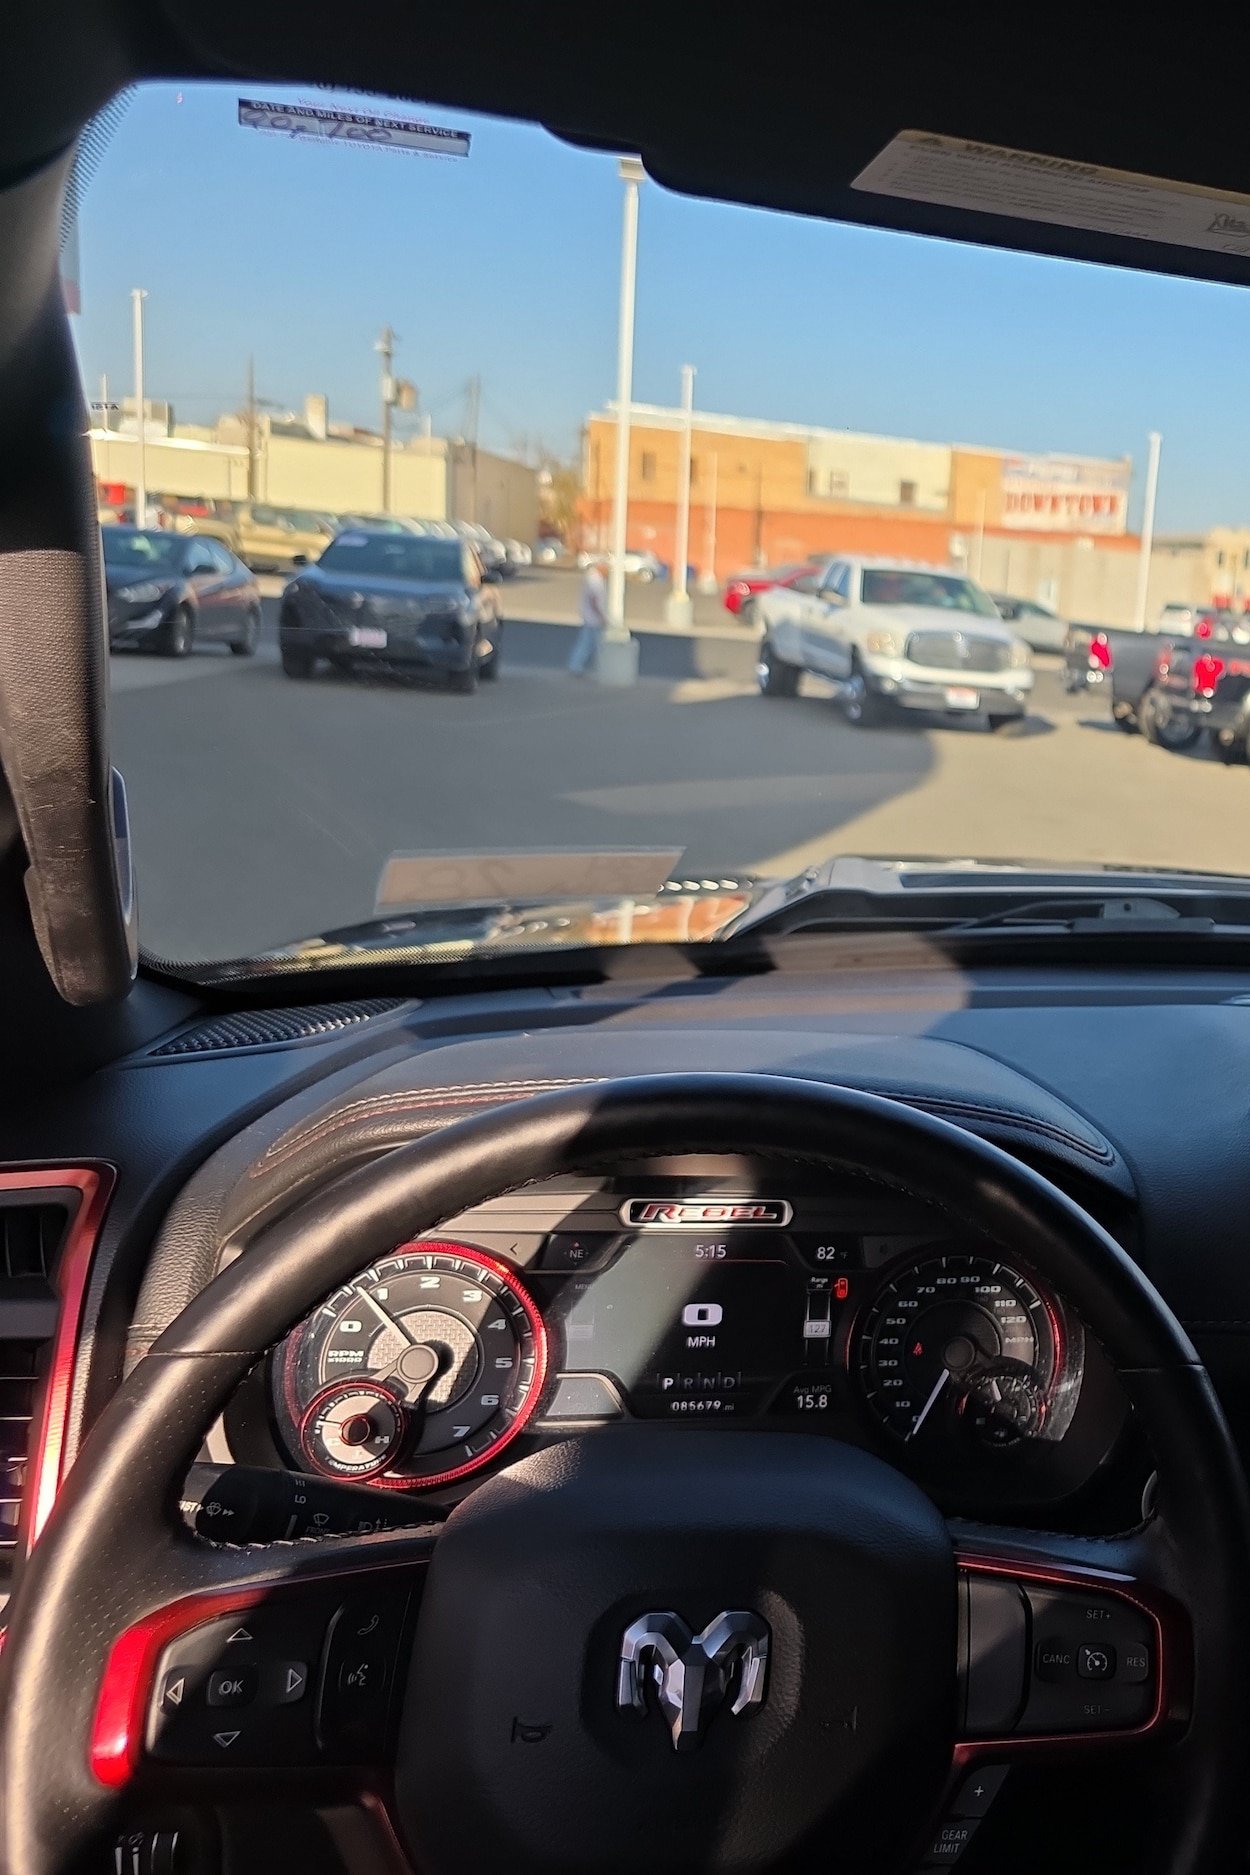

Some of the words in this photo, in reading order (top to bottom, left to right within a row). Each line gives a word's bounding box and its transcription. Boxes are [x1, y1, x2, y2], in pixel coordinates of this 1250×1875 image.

[252, 102, 285, 113] DATE
[288, 107, 314, 118] AND
[317, 111, 353, 122] MILES
[356, 115, 372, 126] OF
[374, 119, 405, 130] NEXT
[408, 123, 459, 138] SERVICE
[965, 142, 1100, 176] WARNING
[639, 1203, 777, 1223] REBEL
[569, 1249, 584, 1259] NE
[695, 1244, 727, 1259] 5:15
[817, 1246, 835, 1260] 82
[419, 1276, 441, 1289] 2
[936, 1277, 957, 1285] 80
[960, 1275, 980, 1283] 90
[376, 1287, 390, 1301] 1
[462, 1289, 483, 1303] 3
[898, 1300, 918, 1308] 60
[994, 1299, 1017, 1307] 110
[683, 1303, 724, 1326] 0
[1001, 1315, 1027, 1324] 120
[339, 1320, 363, 1333] 0
[487, 1318, 507, 1331] 4
[886, 1317, 906, 1325] 50
[810, 1323, 826, 1333] 127
[687, 1336, 716, 1347] MPH
[879, 1337, 899, 1345] 40
[328, 1350, 364, 1358] RPM
[495, 1357, 514, 1369] 5
[878, 1359, 898, 1367] 30
[664, 1377, 674, 1390] P
[703, 1377, 715, 1389] N
[724, 1376, 736, 1388] D
[883, 1379, 903, 1387] 20
[811, 1384, 832, 1394] MPG
[480, 1394, 500, 1406] 6
[797, 1394, 829, 1409] 15.8
[895, 1400, 910, 1408] 10
[671, 1401, 722, 1411] 085679
[452, 1425, 471, 1438] 7
[374, 1435, 390, 1444] H
[294, 1495, 306, 1504] LO
[180, 1501, 198, 1512] IST
[1042, 1653, 1071, 1664] CANC
[1126, 1656, 1146, 1668] RES
[219, 1680, 244, 1695] OK
[941, 1829, 968, 1840] GEAR
[933, 1843, 961, 1853] LIMIT
